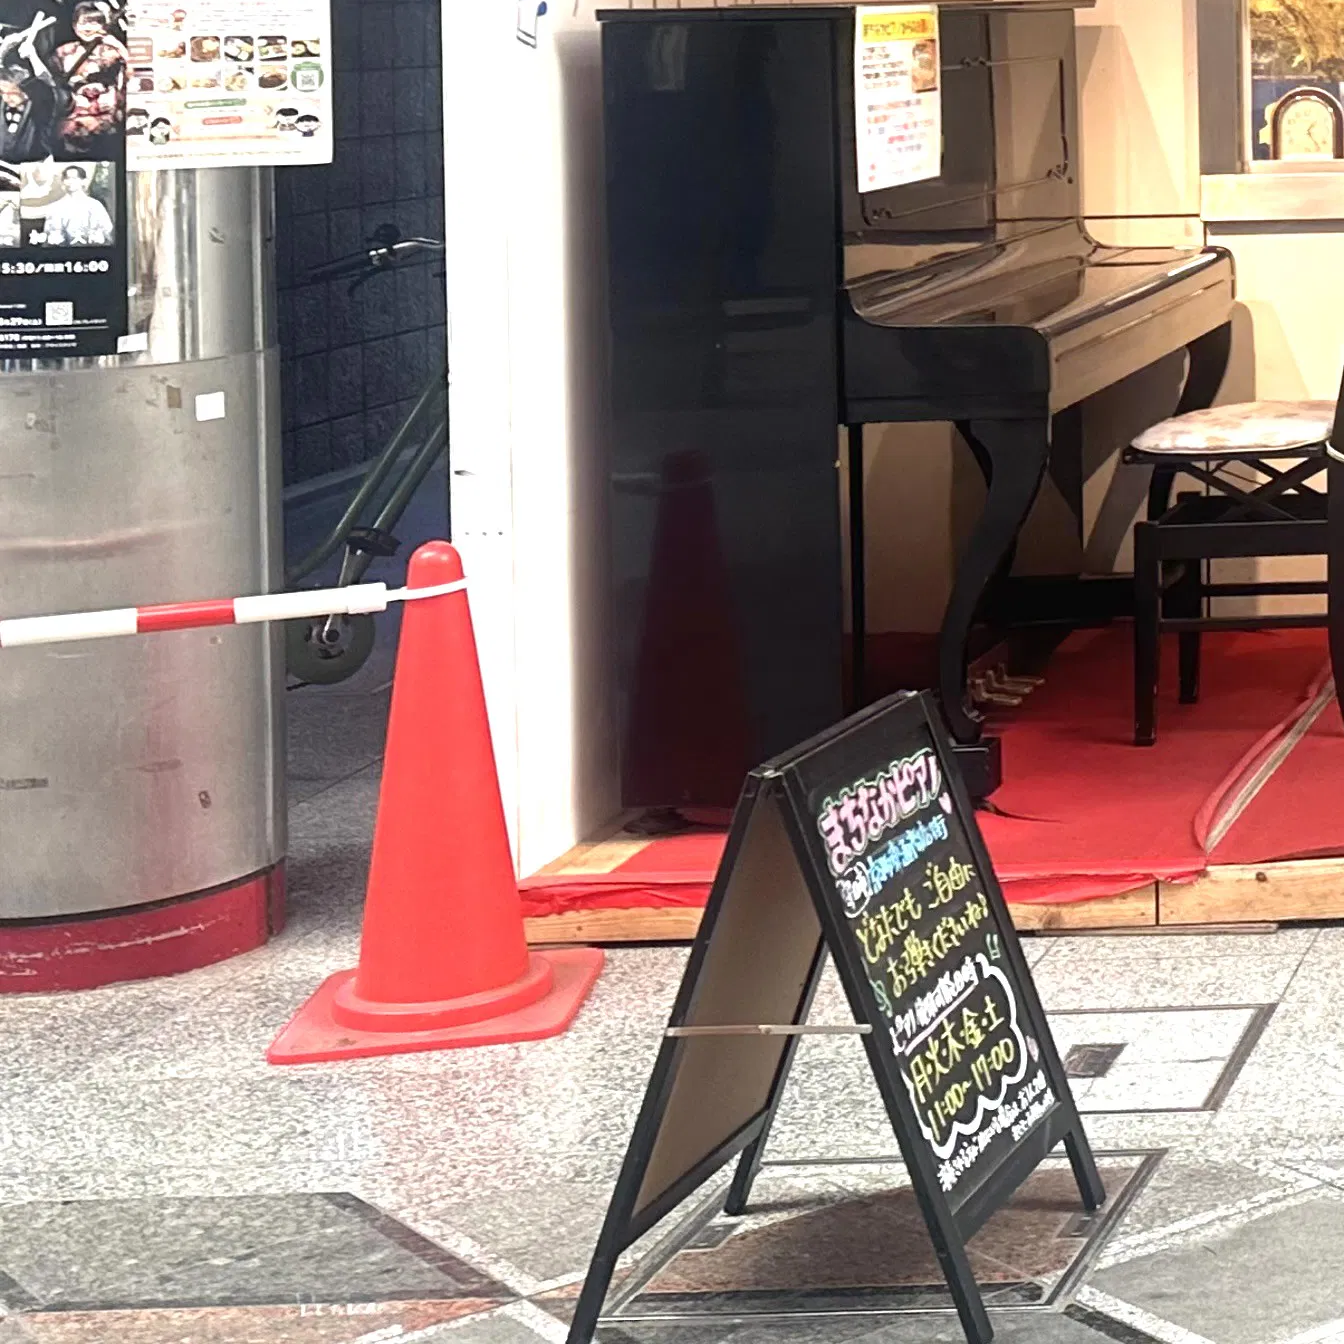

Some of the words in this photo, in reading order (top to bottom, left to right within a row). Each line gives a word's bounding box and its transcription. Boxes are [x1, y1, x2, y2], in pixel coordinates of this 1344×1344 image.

[819, 750, 940, 875] まちなかピアノ
[856, 887, 922, 964] どなたでも
[922, 856, 977, 909] ご自由に
